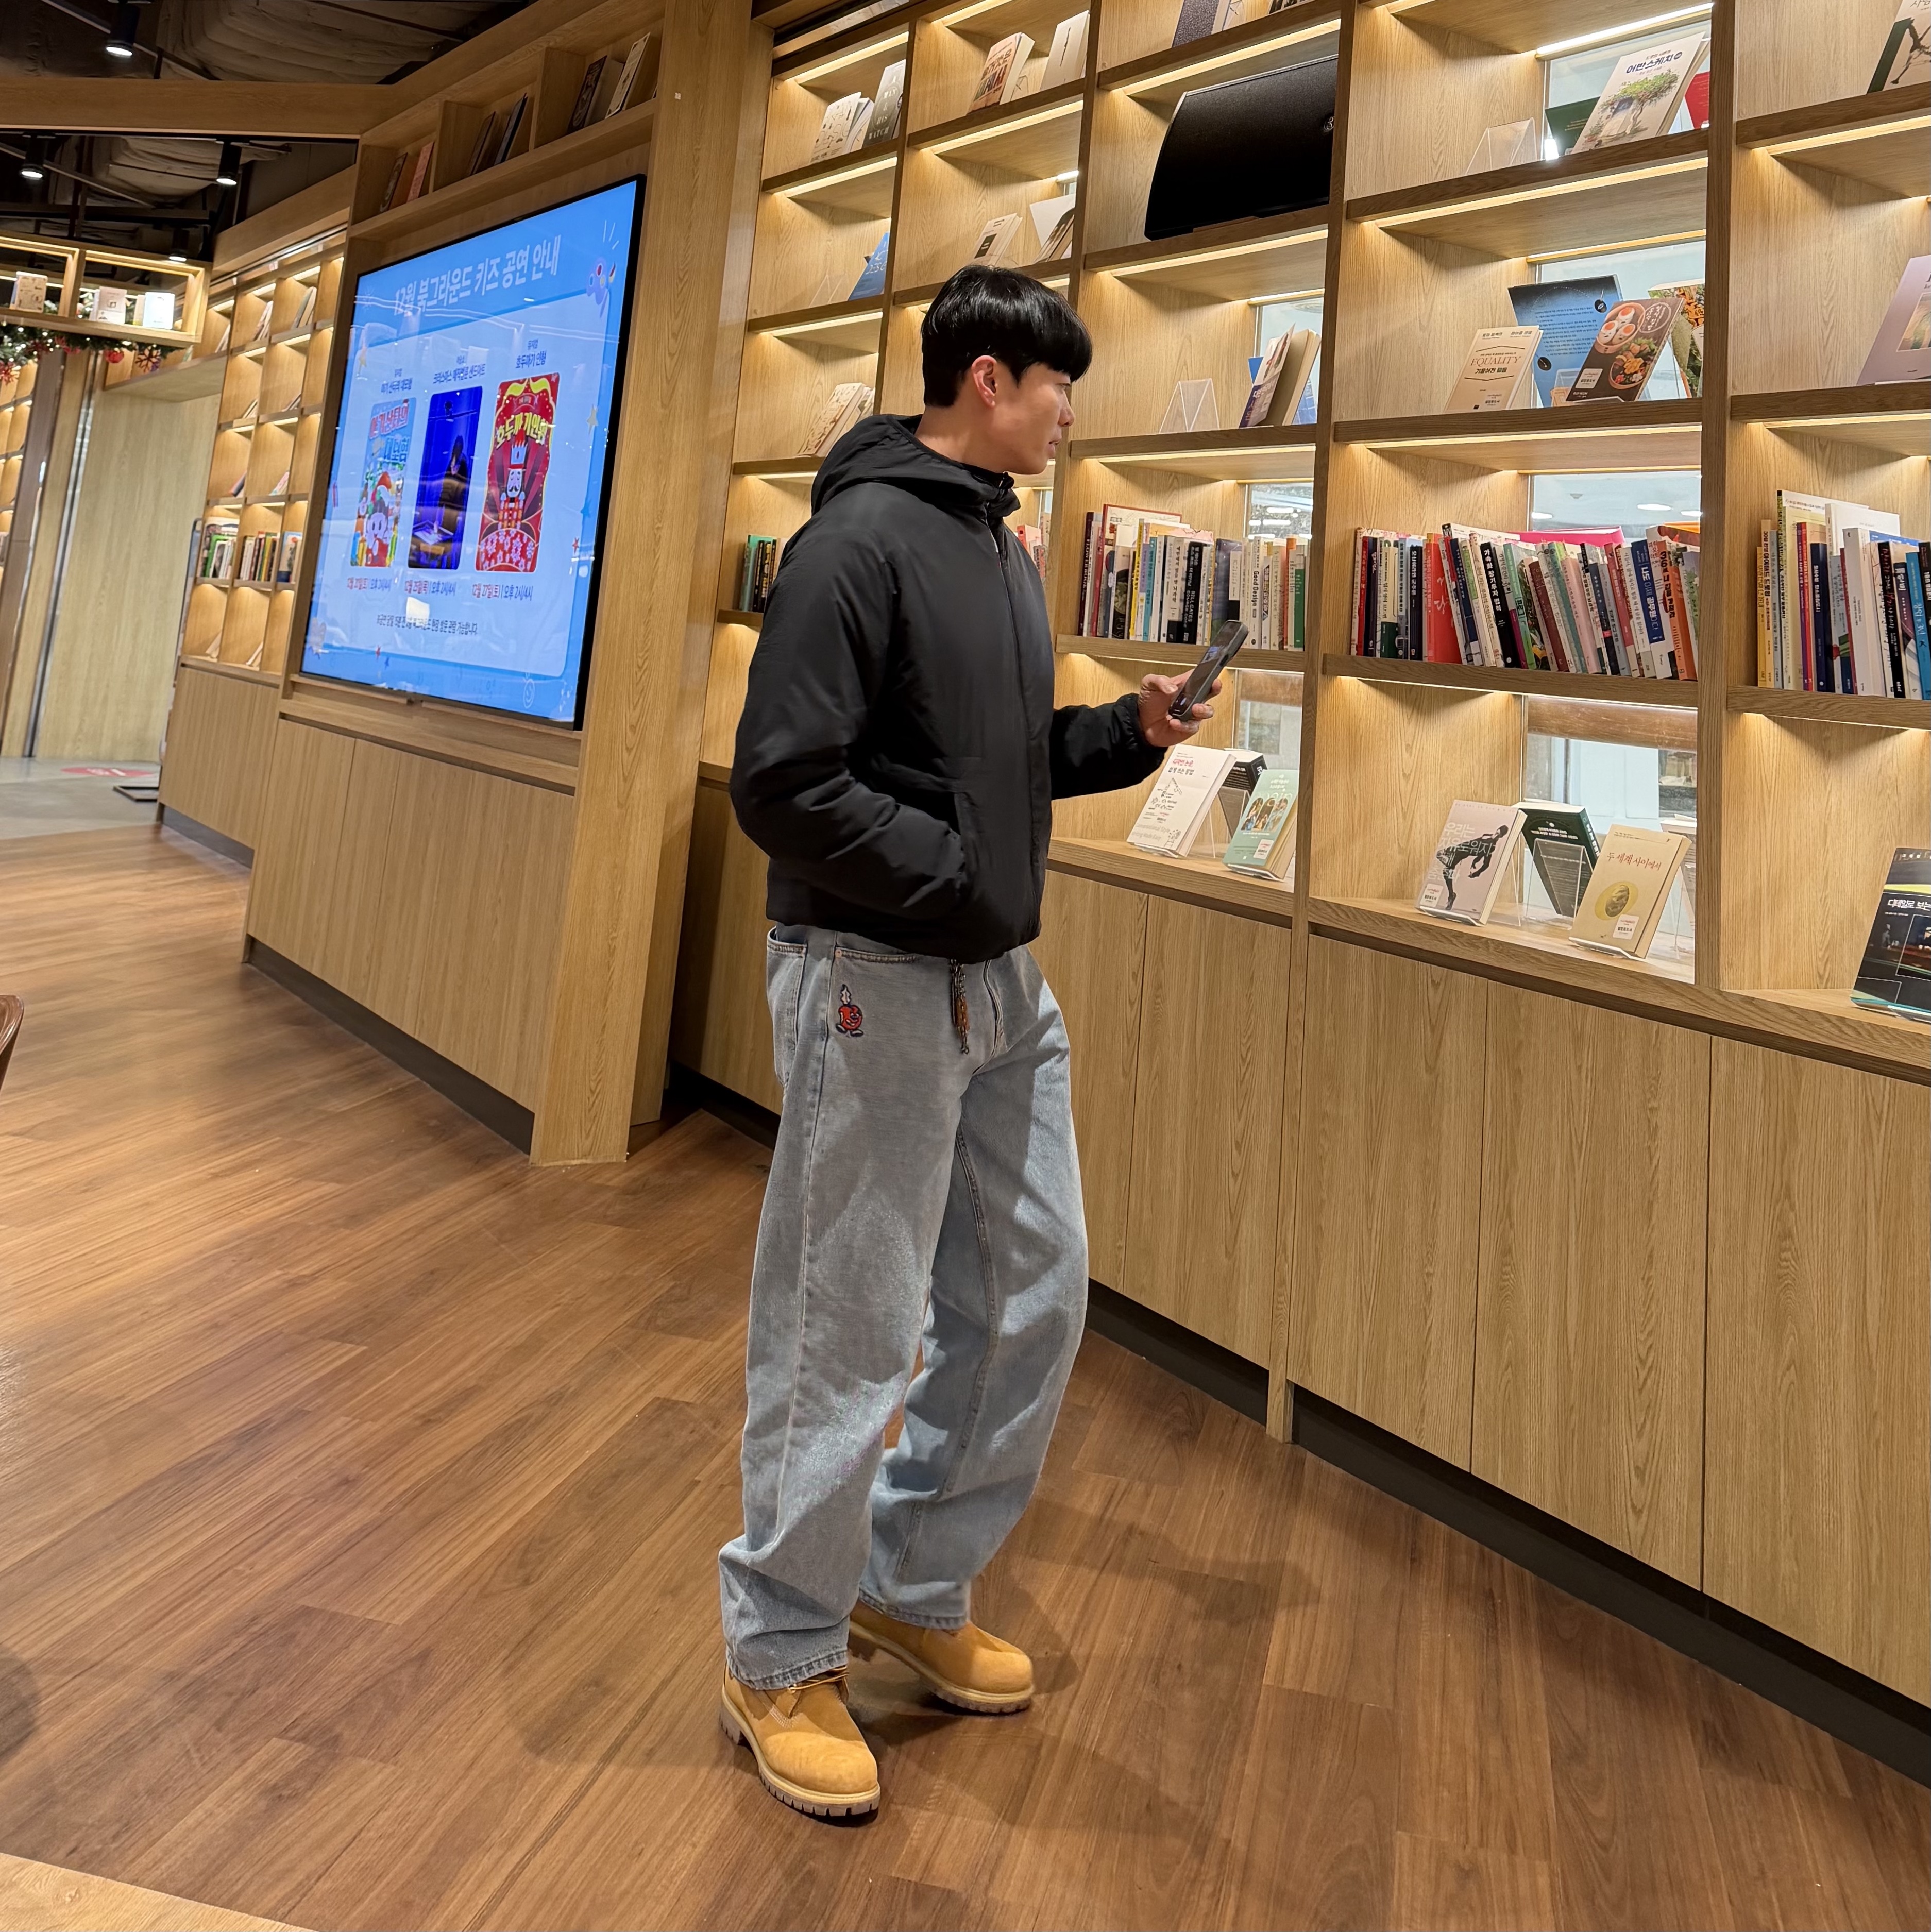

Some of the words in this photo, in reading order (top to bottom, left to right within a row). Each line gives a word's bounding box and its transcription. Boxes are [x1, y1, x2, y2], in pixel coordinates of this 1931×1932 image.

[1626, 54, 1674, 74] 어반스케치
[884, 88, 897, 99] MAN
[876, 115, 888, 125] HIS
[868, 127, 889, 140] WATCH
[394, 281, 416, 316] 12월
[417, 266, 472, 312] 북그라운드
[475, 257, 501, 296] 키즈
[502, 244, 530, 289] 공연
[532, 234, 561, 281] 안내
[515, 352, 535, 369] 호두까기
[536, 350, 547, 366] 인형
[1470, 356, 1521, 367] EQUALITY
[495, 413, 549, 449] 호두까기인형
[1484, 549, 1493, 569] 가속화
[1640, 566, 1651, 582] 나도
[431, 581, 440, 594] 오후
[1487, 570, 1498, 597] 장기투자
[1644, 582, 1652, 597] 이제
[472, 583, 481, 598] 12월
[482, 584, 500, 599] 27일(토)
[503, 585, 514, 599] 오후
[515, 585, 533, 601] 2시/4시
[1646, 596, 1660, 631] 공무원이다
[1913, 602, 1924, 616] 창업
[1444, 822, 1476, 838] 우리는
[1607, 852, 1615, 861] 두
[1616, 853, 1633, 866] 세계
[1633, 857, 1662, 871] 사이에서
[1915, 901, 1931, 911] 보는
